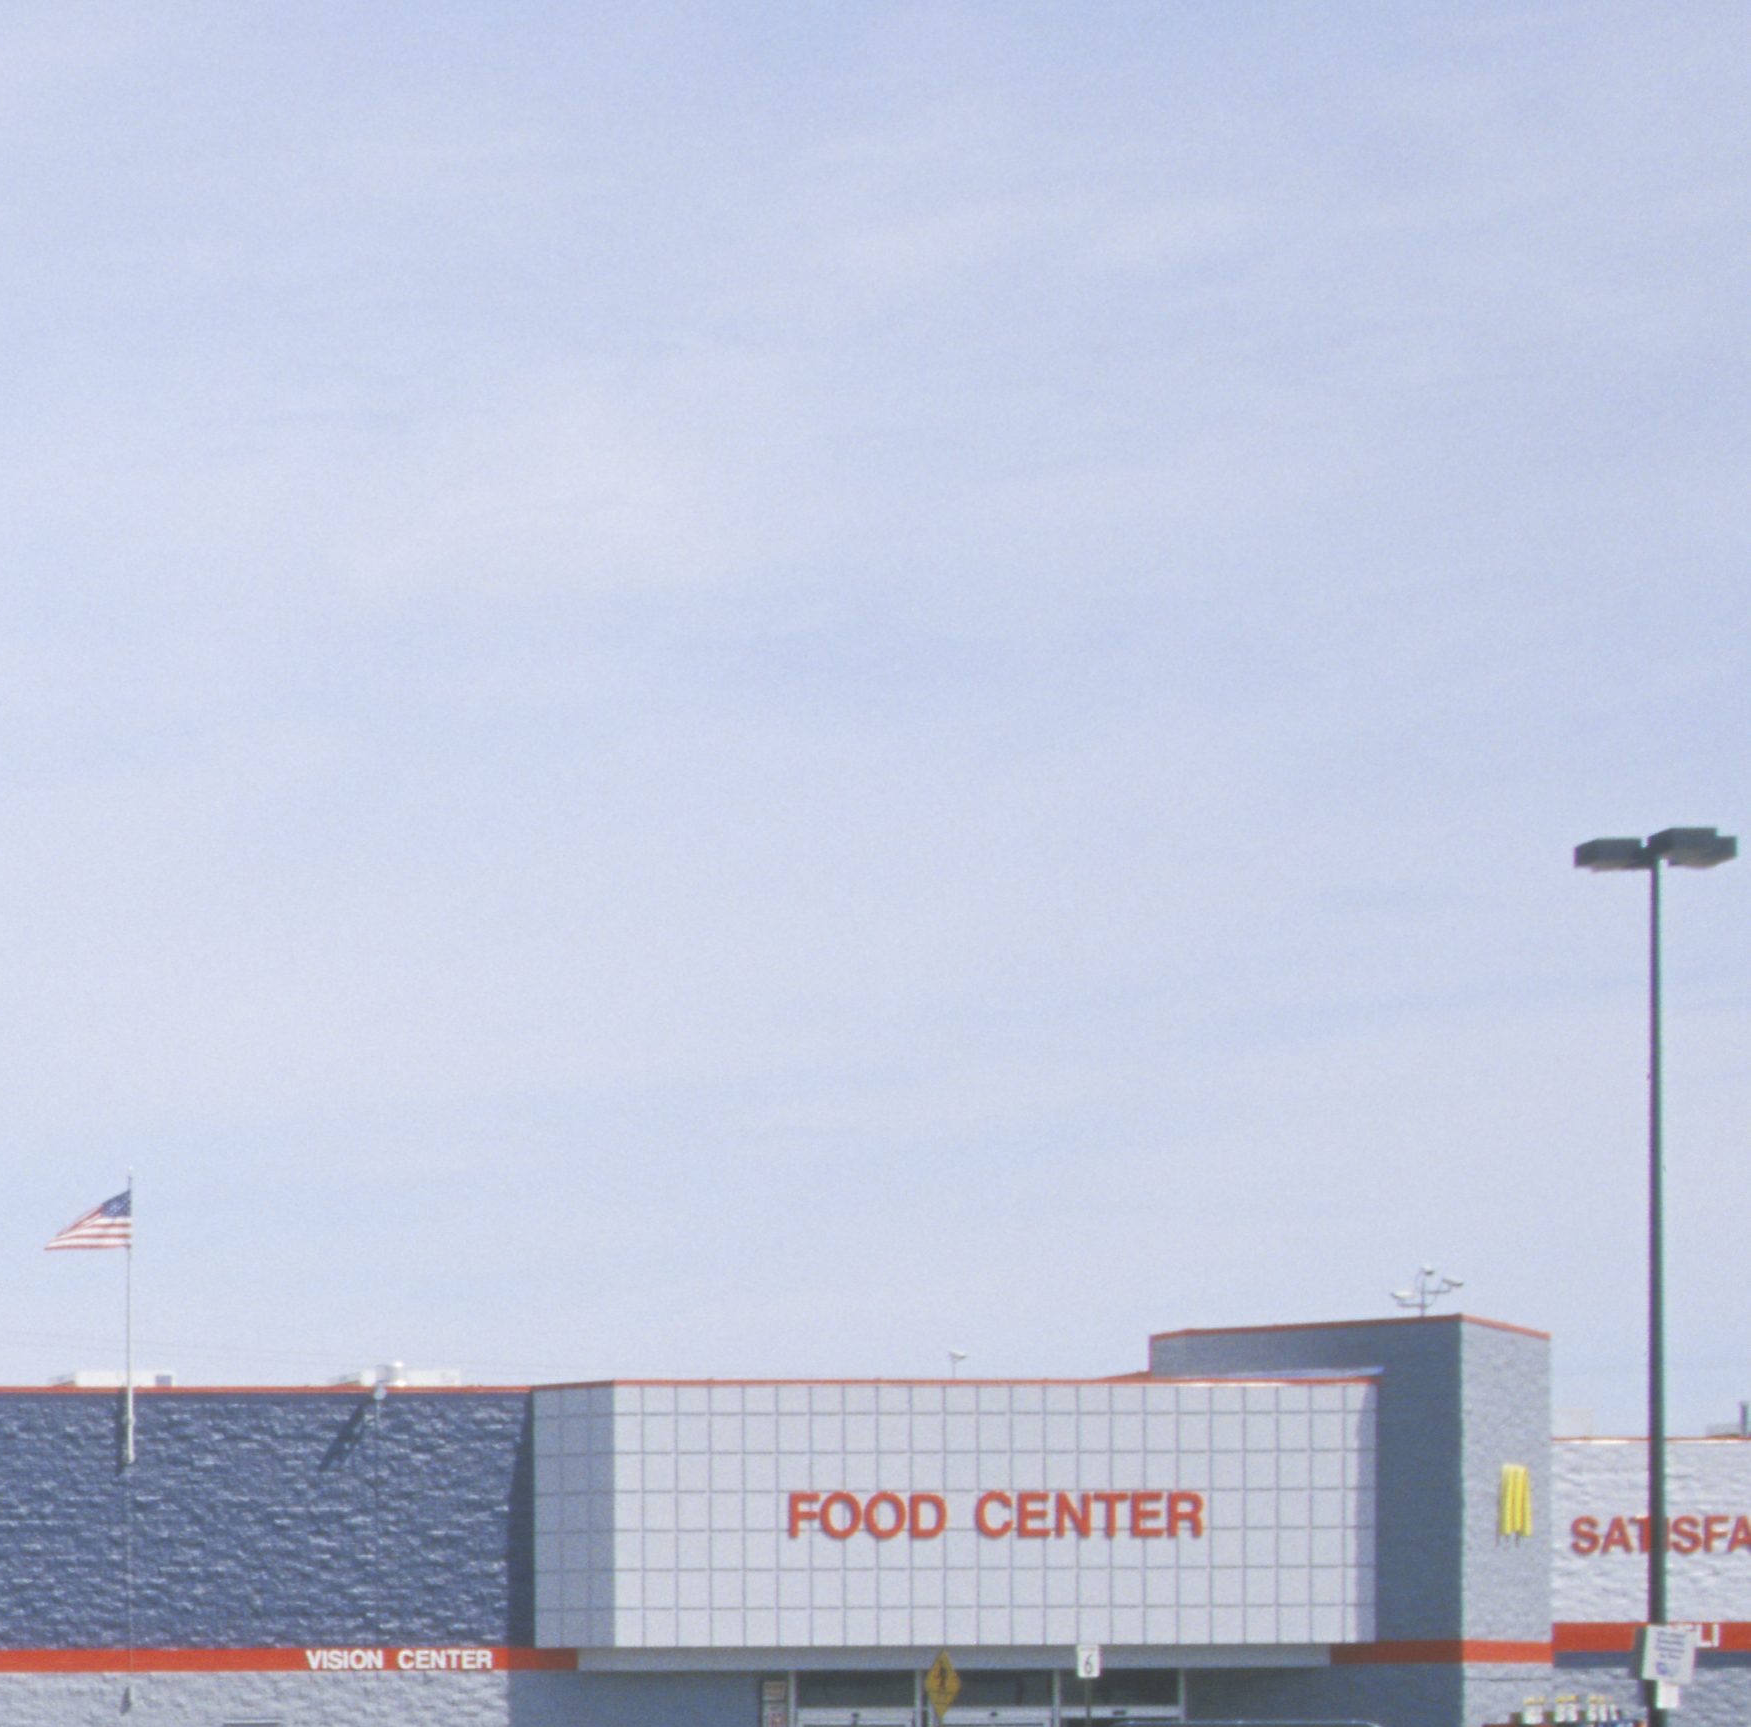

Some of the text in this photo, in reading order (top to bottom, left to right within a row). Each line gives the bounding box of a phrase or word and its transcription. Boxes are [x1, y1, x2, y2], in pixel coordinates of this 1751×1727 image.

[788, 1489, 1204, 1540] FOOD CENTER
[305, 1649, 493, 1670] VISION CENTER
